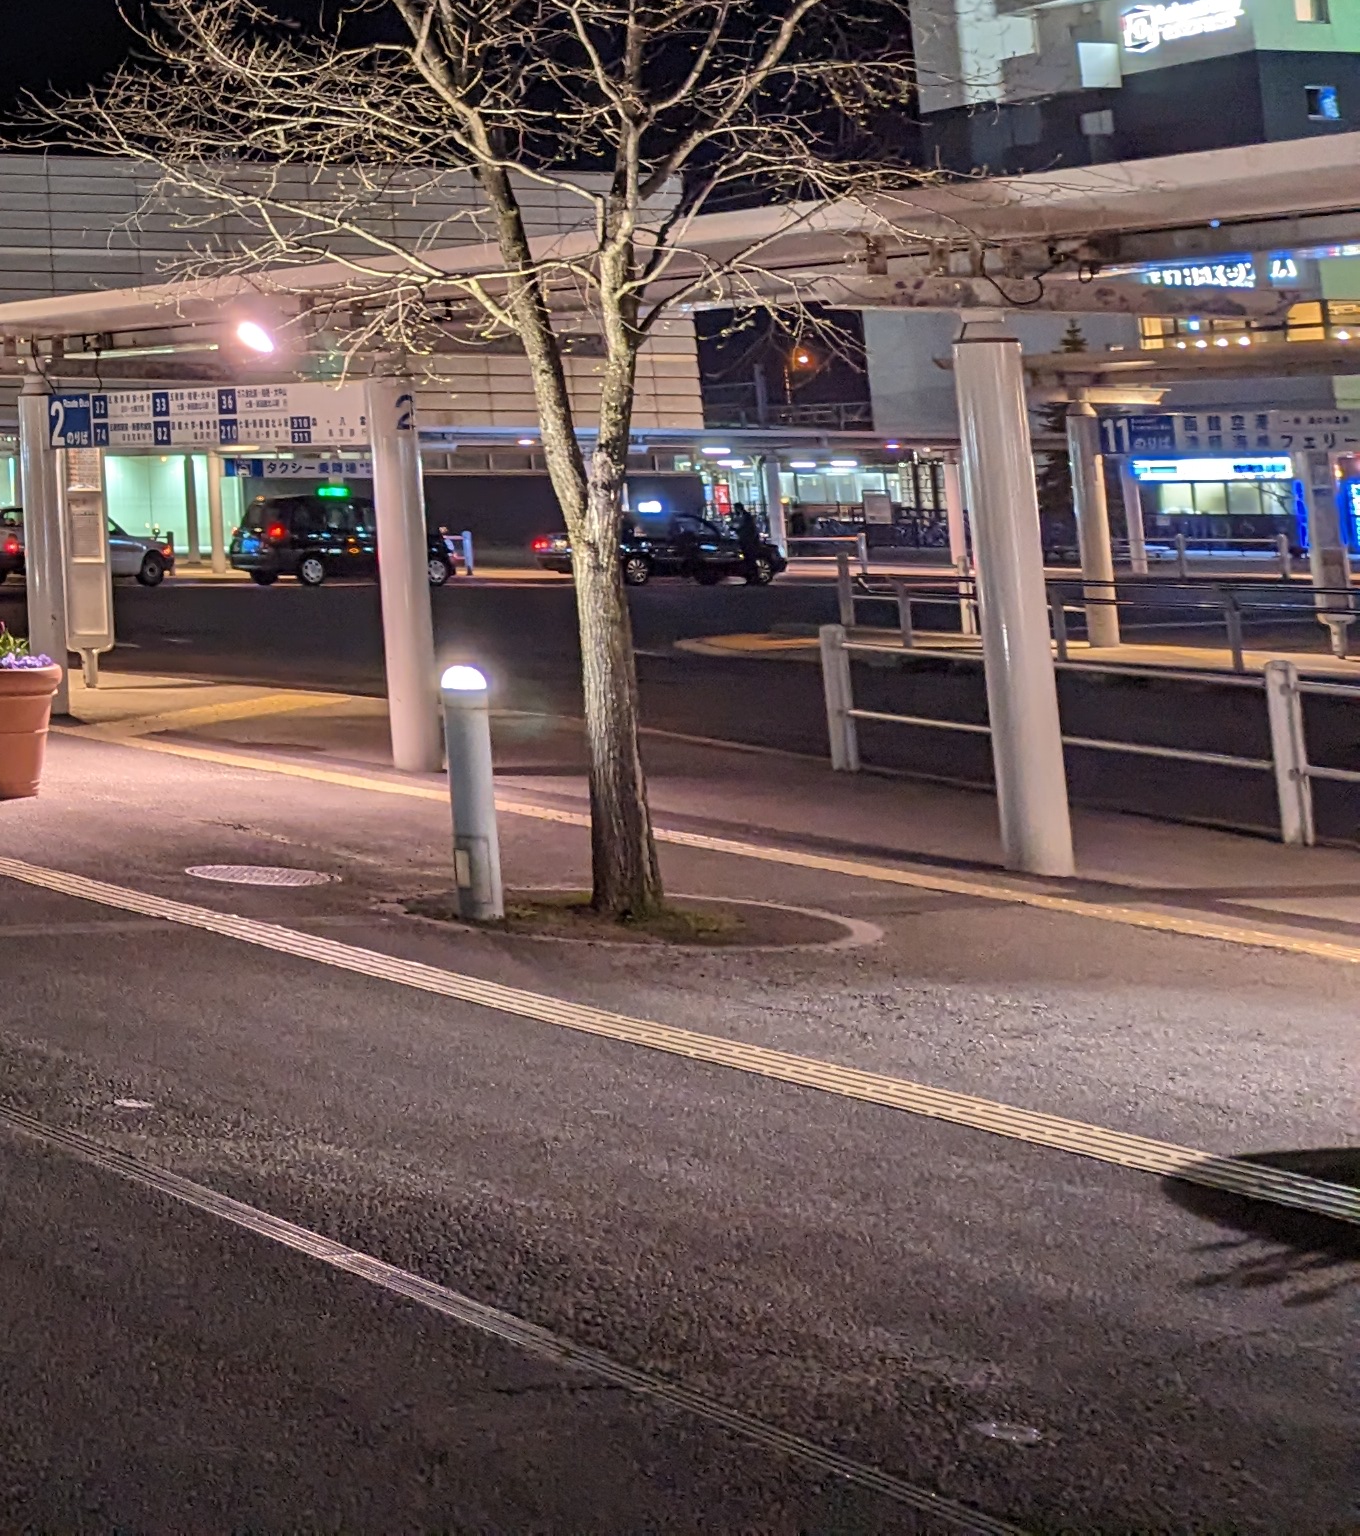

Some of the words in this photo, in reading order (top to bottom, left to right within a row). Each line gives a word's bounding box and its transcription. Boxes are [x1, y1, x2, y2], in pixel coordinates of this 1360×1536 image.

[95, 401, 106, 414] 32
[155, 398, 167, 412] 33
[221, 395, 234, 410] 36
[394, 394, 415, 430] 2
[49, 400, 66, 447] 2
[292, 418, 309, 429] 310
[66, 430, 89, 446] のりば
[96, 428, 107, 442] 74
[156, 427, 168, 441] 82
[220, 425, 237, 440] 210
[293, 432, 309, 443] 311
[1102, 418, 1130, 453] 11
